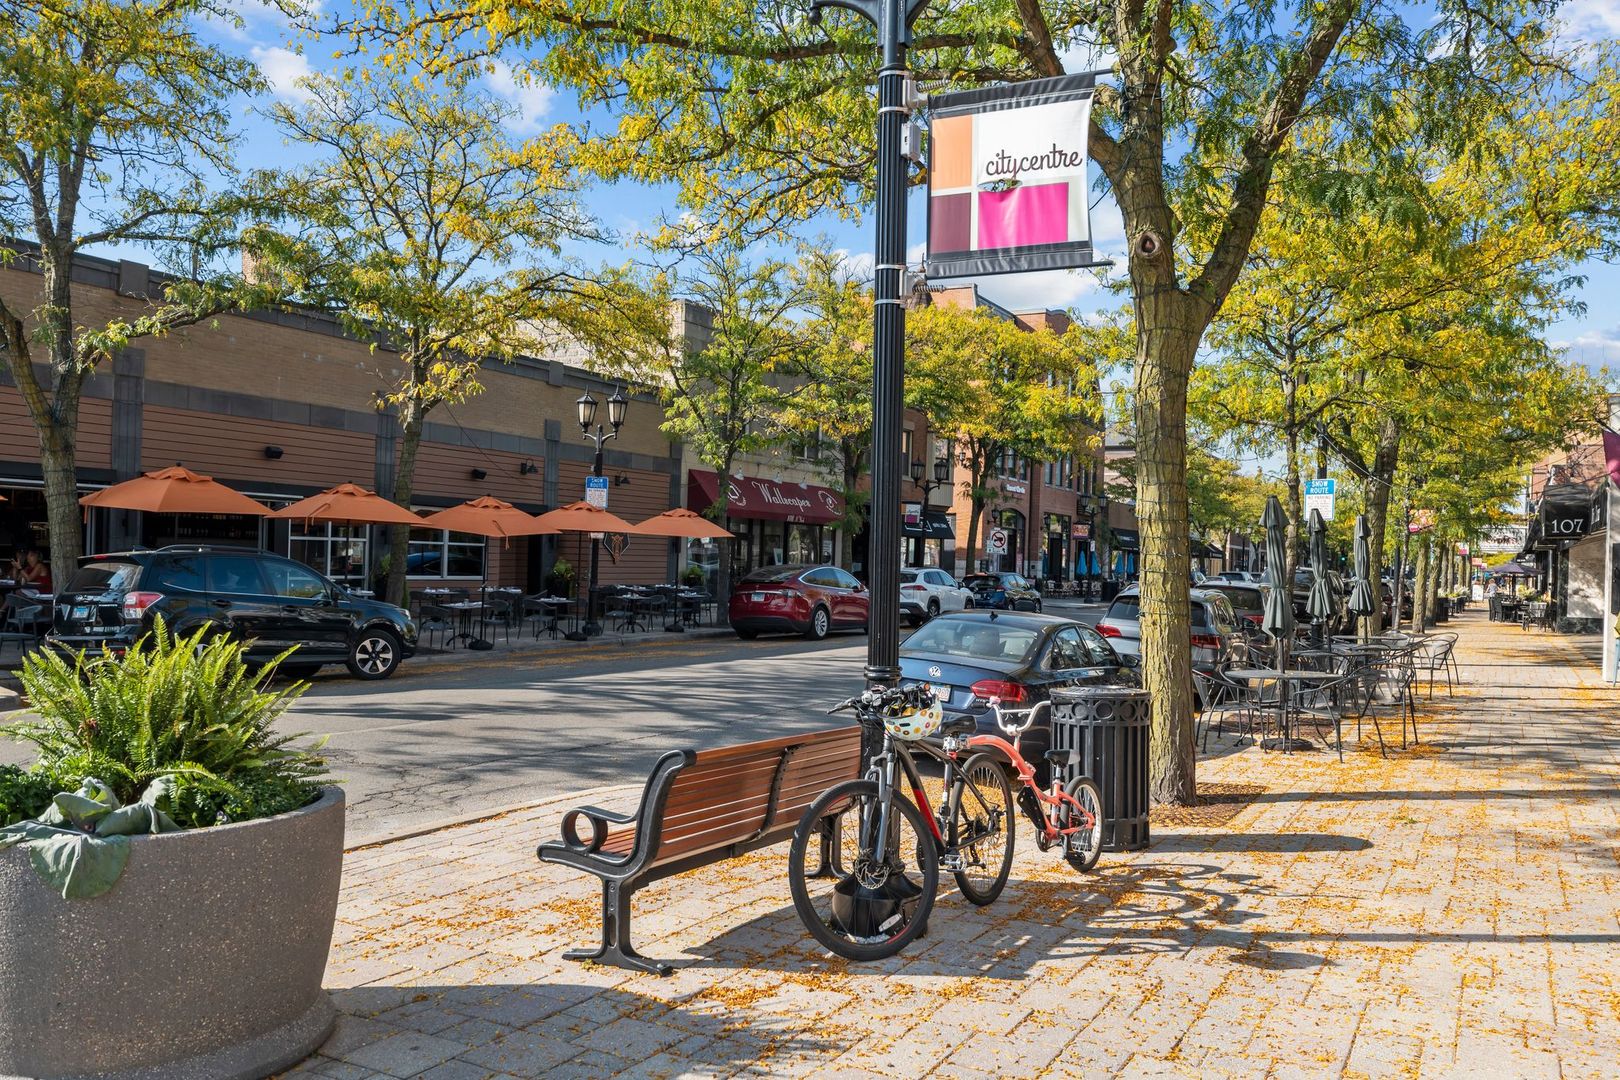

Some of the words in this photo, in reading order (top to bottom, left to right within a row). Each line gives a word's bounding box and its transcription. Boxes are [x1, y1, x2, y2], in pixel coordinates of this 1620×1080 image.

[986, 143, 1083, 180] citycentre
[751, 481, 811, 512] Wallscapes
[1551, 519, 1584, 534] 107
